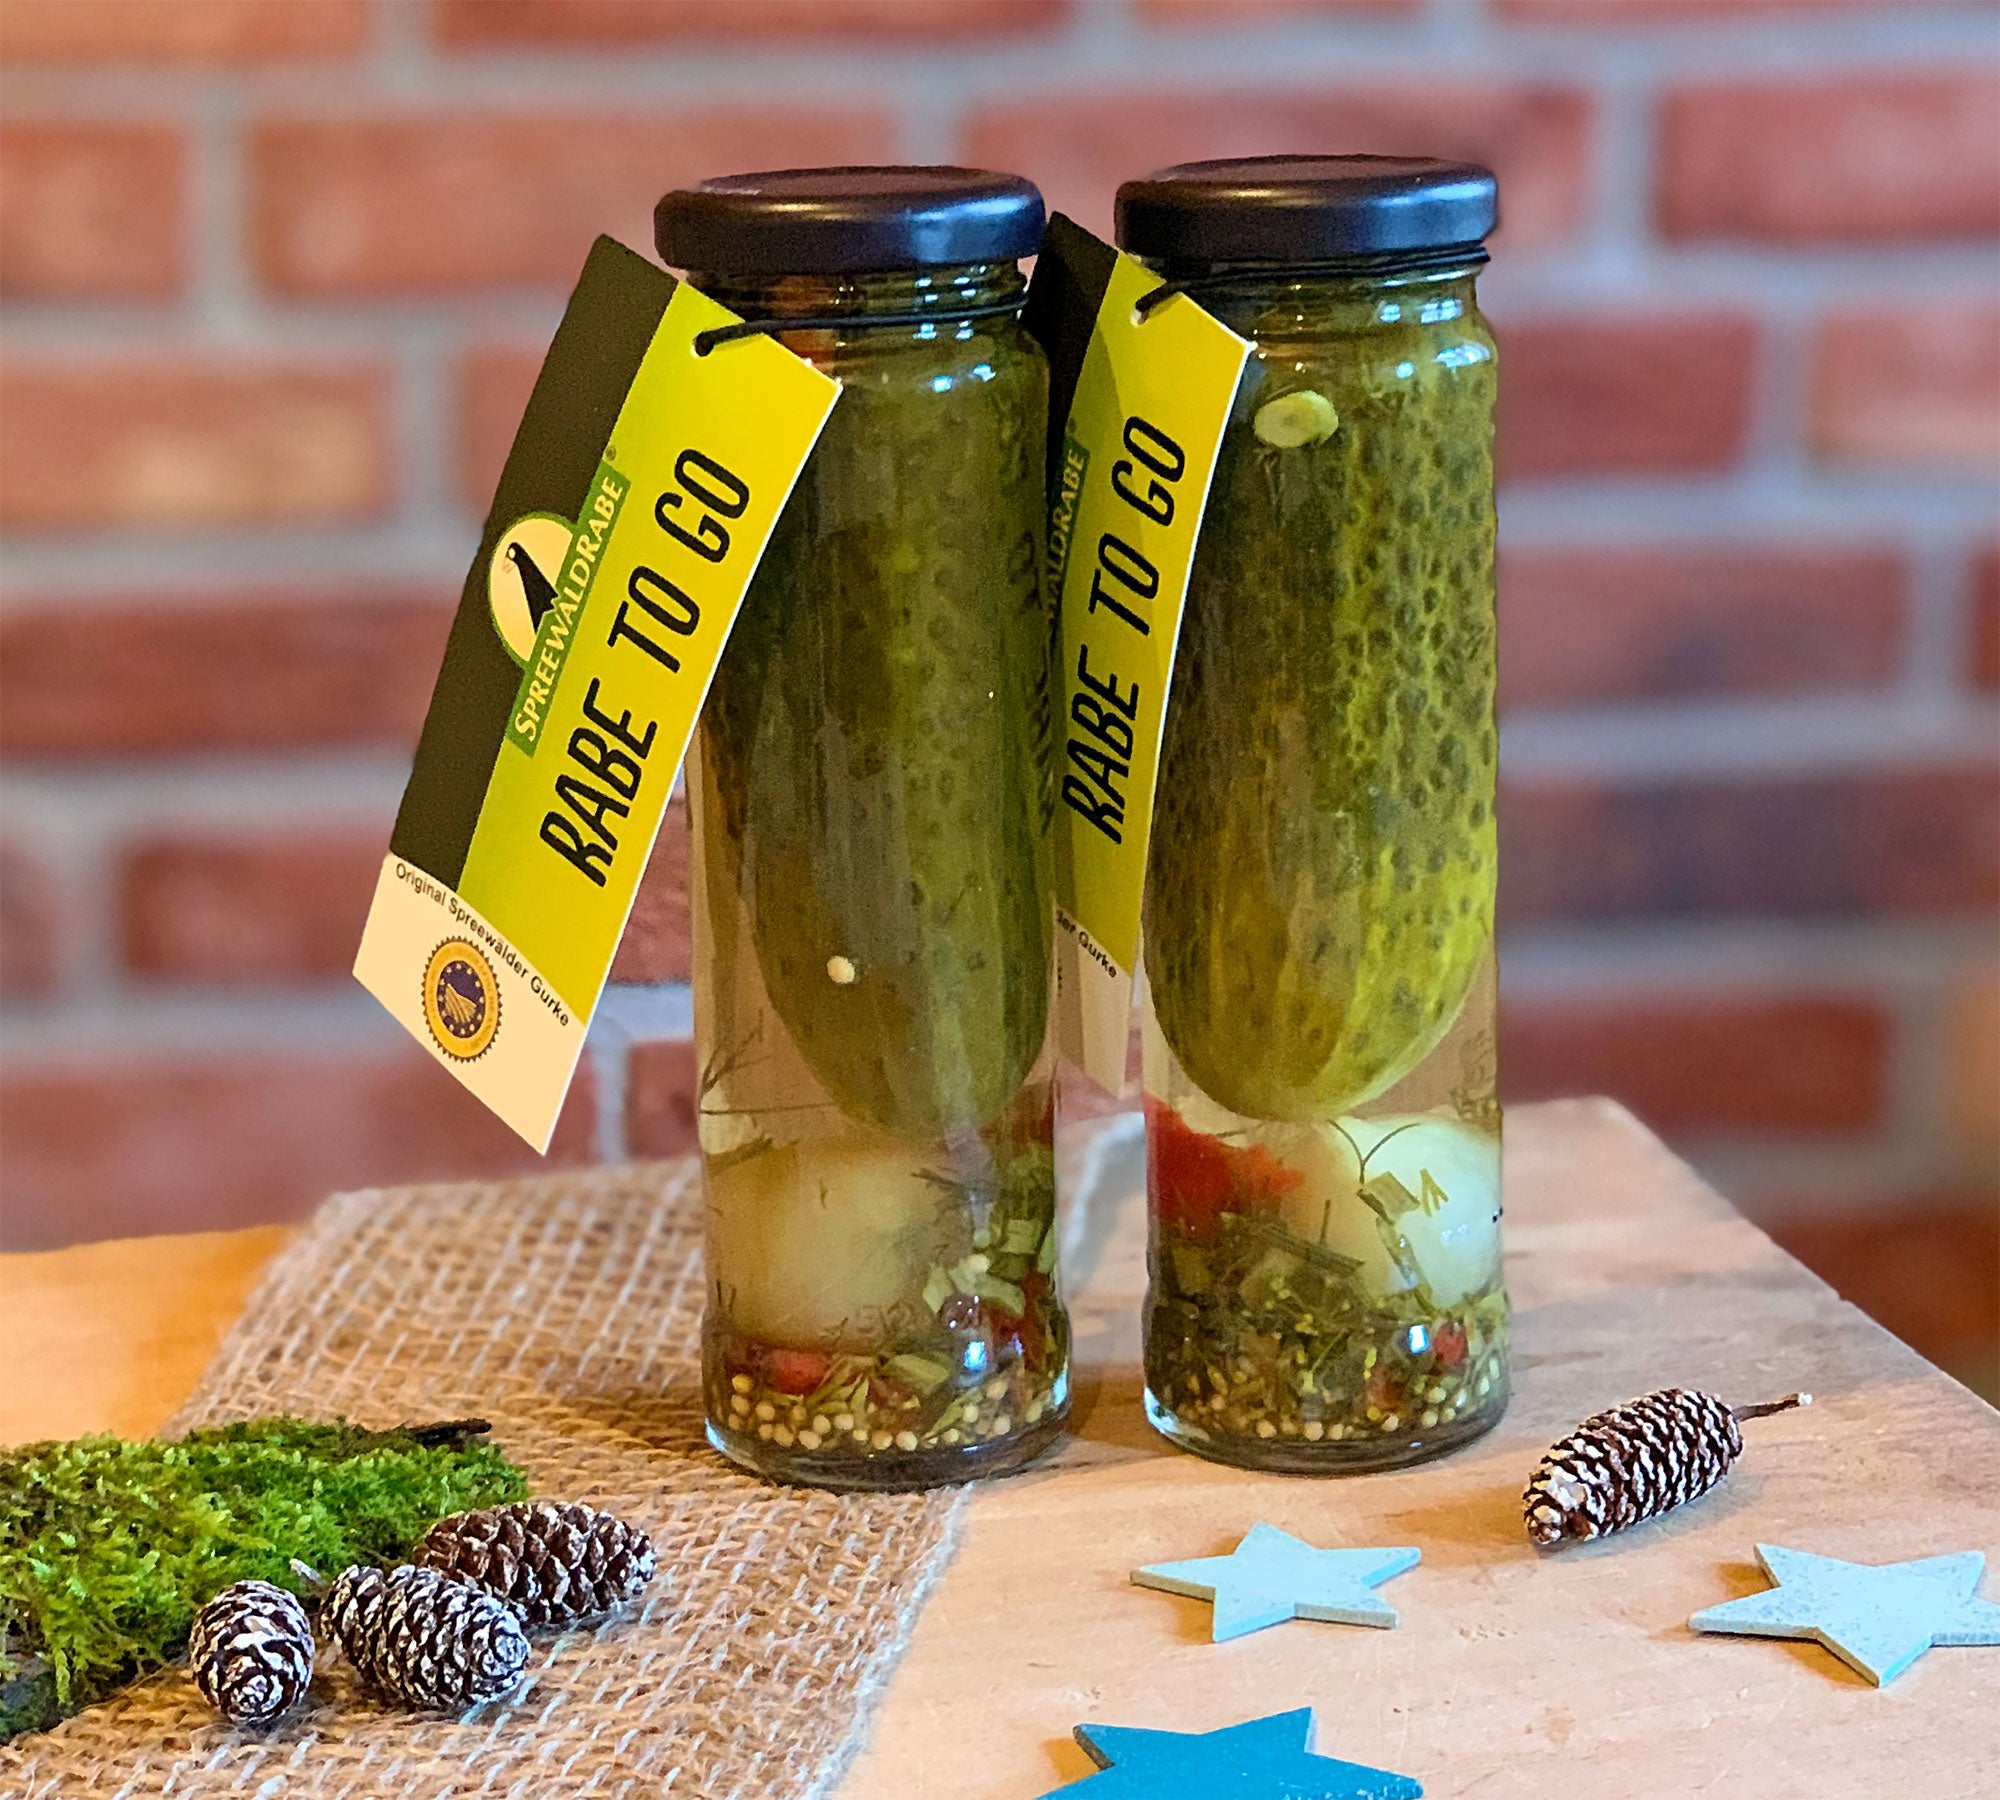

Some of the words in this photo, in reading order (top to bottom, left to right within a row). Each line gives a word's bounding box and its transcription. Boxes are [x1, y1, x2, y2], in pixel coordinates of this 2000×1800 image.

[1111, 416, 1185, 527] GO
[514, 476, 624, 742] SPREEWALDRABE
[1088, 532, 1160, 637] TO
[539, 677, 658, 888] RABE
[607, 565, 701, 674] TO
[654, 448, 750, 564] GO
[1061, 643, 1139, 845] RABE
[395, 862, 447, 906] Original
[449, 896, 529, 979] Spreewälder
[530, 975, 569, 1027] Gurke
[1079, 931, 1117, 978] Gurke
